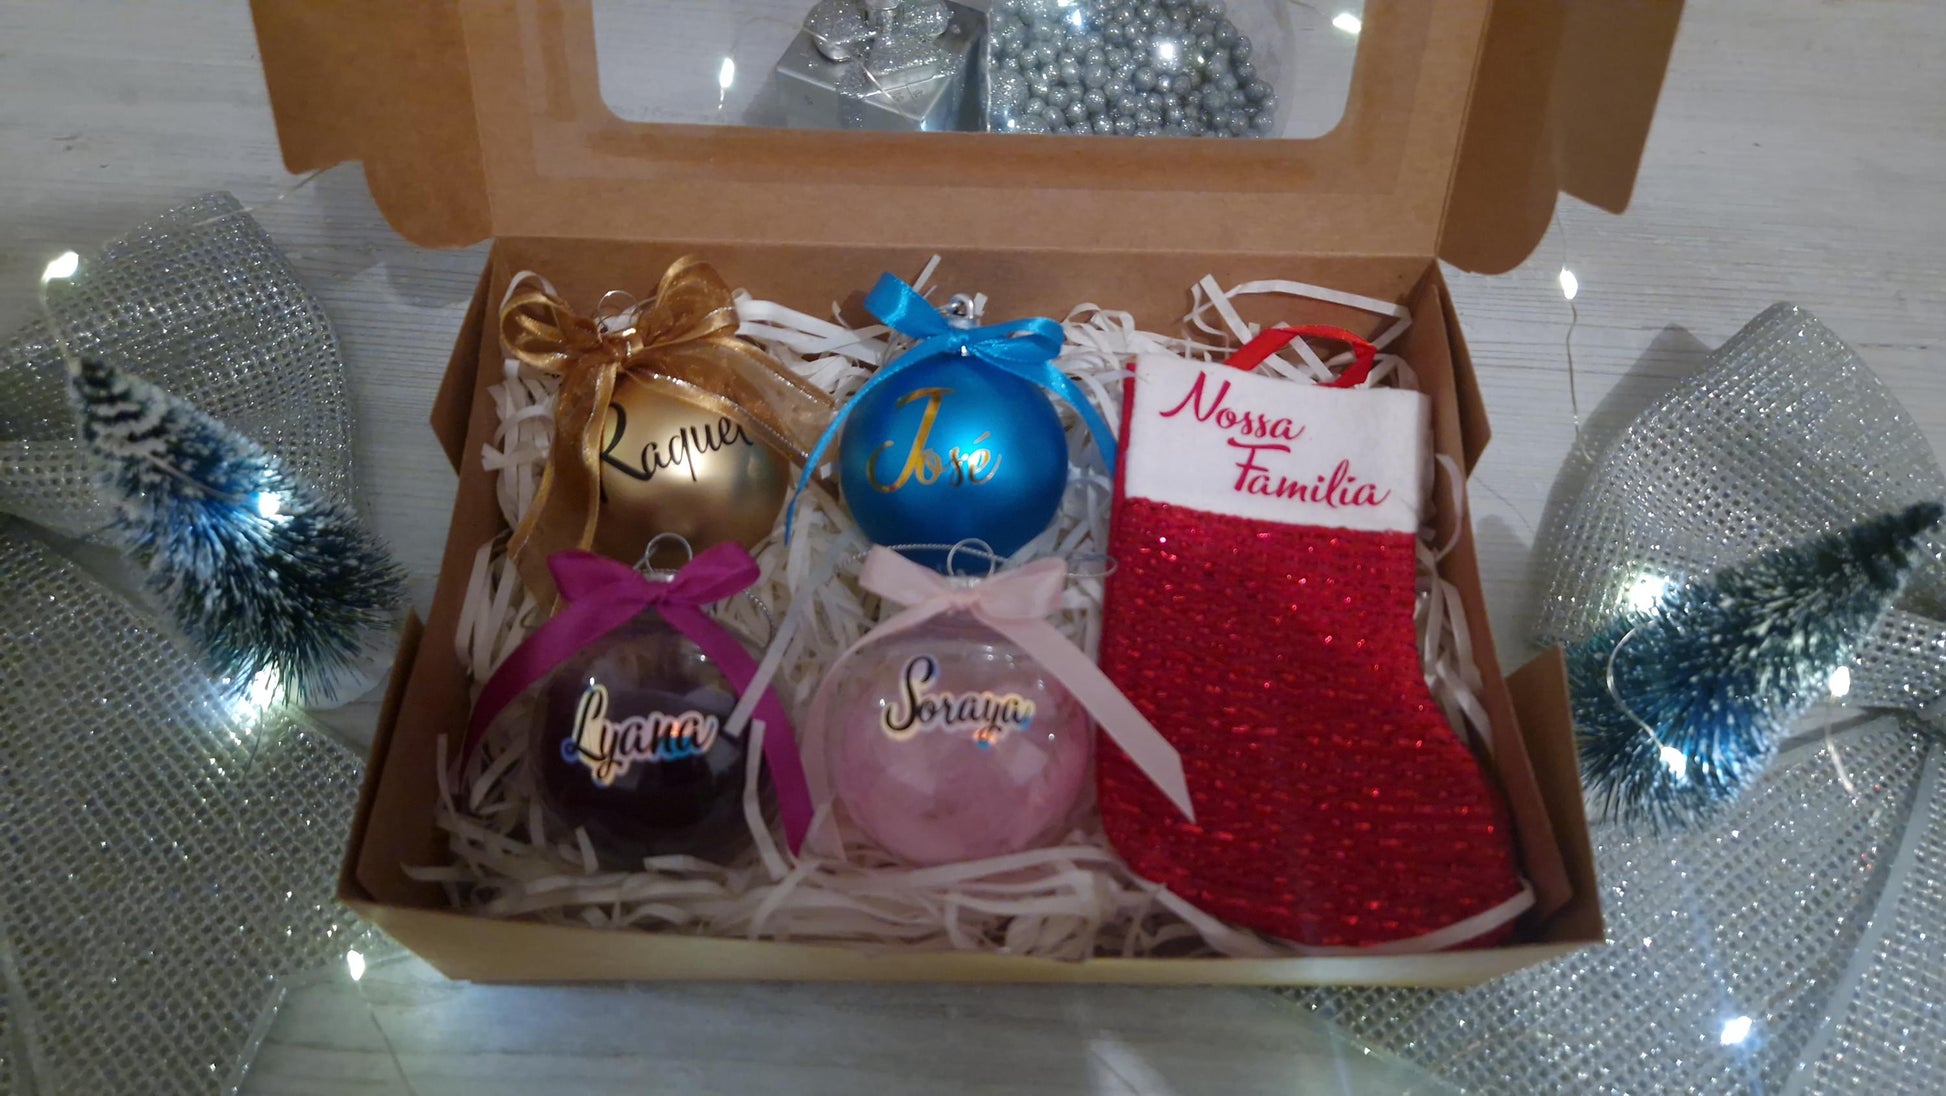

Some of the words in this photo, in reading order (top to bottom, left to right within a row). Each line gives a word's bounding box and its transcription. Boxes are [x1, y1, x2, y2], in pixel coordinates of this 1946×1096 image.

[867, 387, 1002, 492] José
[1160, 371, 1305, 440] Nossa
[1227, 437, 1391, 508] Familia
[563, 685, 718, 786] Lyana
[881, 656, 1032, 746] Soraya
